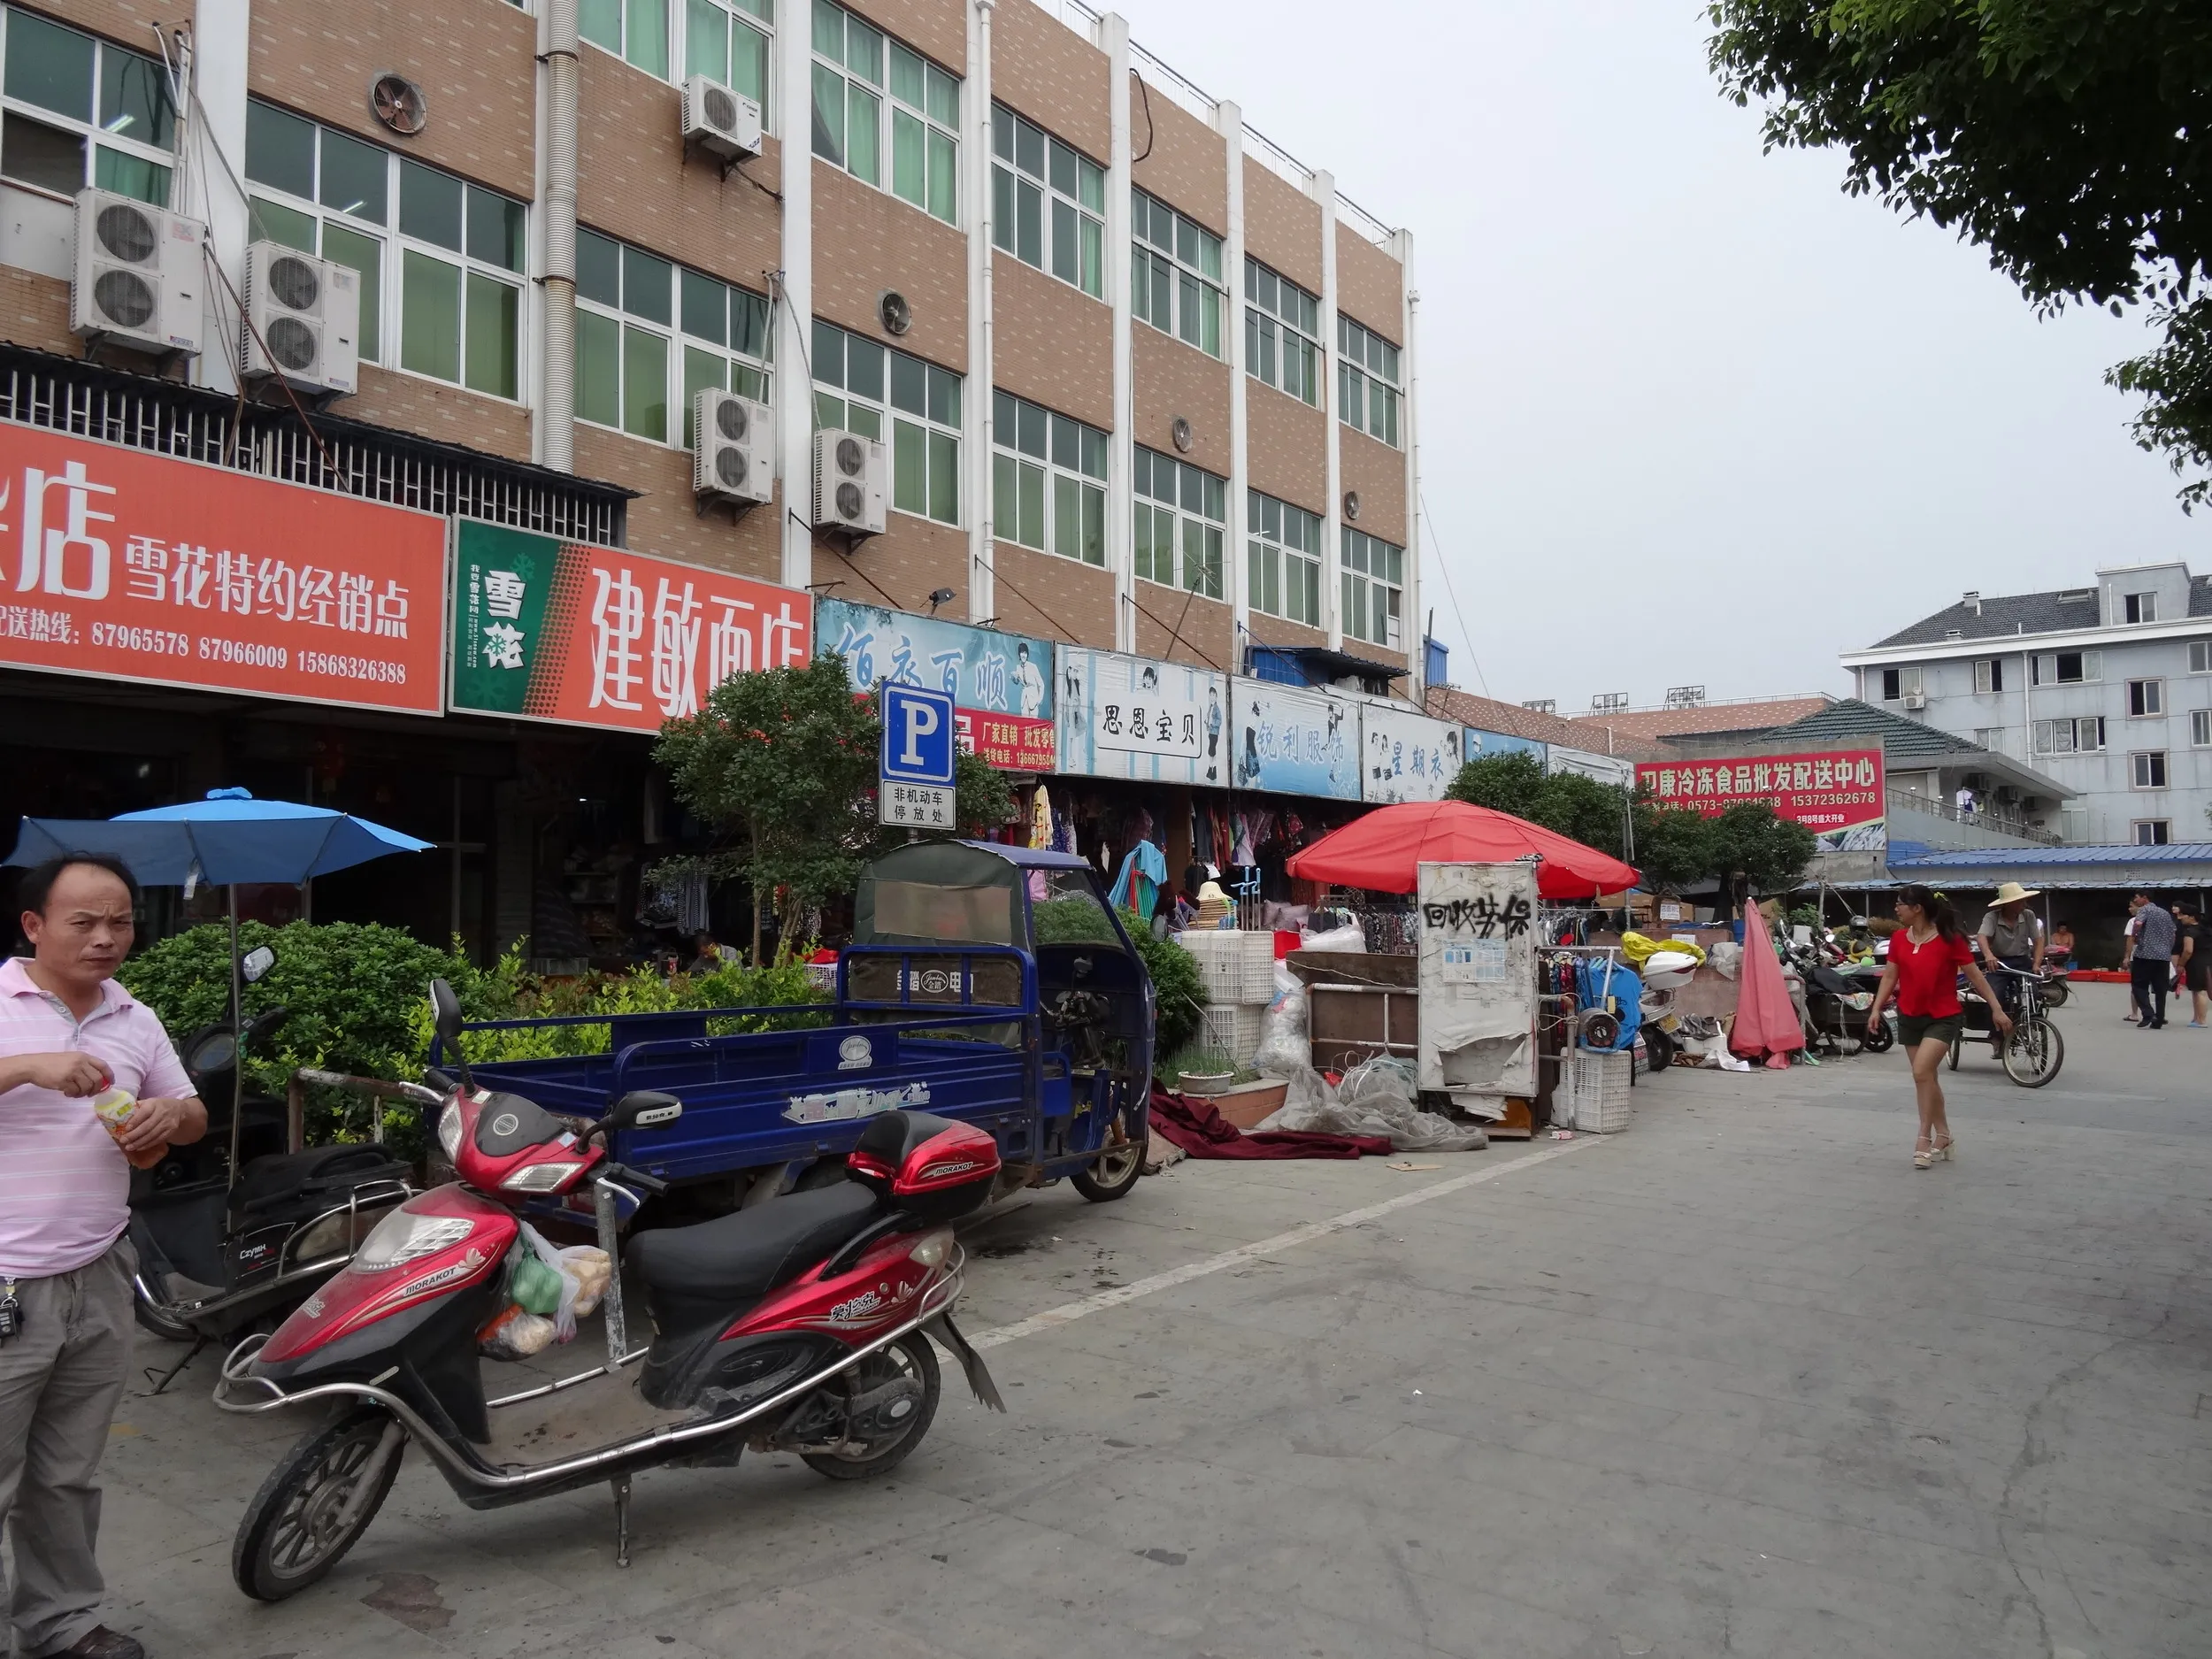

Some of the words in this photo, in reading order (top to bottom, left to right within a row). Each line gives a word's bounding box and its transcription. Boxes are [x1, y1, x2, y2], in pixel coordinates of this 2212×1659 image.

[126, 534, 409, 640] 雪花特约经销点
[481, 570, 526, 670] 雪花
[91, 622, 190, 657] 87965578
[198, 641, 288, 670] 87966009
[297, 651, 407, 685] 15868326388
[900, 699, 939, 766] P
[982, 722, 1018, 746] 厂家直销
[1256, 720, 1344, 772] 锐利服饰
[1640, 757, 1875, 798] 卫康冷冻食品批发配送中心
[894, 787, 943, 806] 非机动车
[1791, 792, 1876, 806] 15372362678
[895, 805, 943, 824] 停放处
[935, 1162, 973, 1176] MORAKOT
[405, 1267, 456, 1295] MORAKOT
